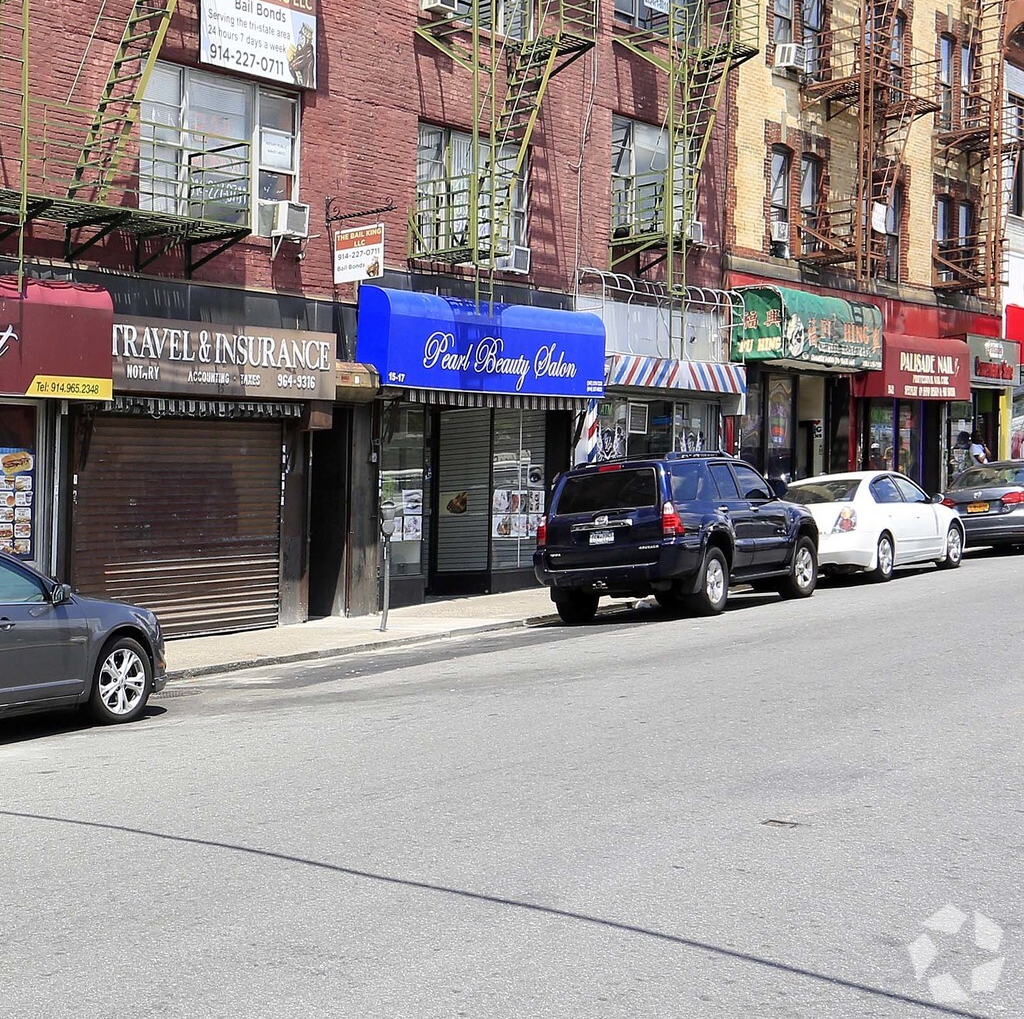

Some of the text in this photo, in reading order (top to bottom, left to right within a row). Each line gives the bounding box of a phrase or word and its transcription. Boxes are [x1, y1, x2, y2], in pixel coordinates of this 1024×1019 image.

[257, 3, 286, 23] Bonds
[208, 8, 291, 40] Serving the tri-state area
[208, 24, 217, 35] 24
[218, 28, 238, 41] hours
[240, 33, 245, 42] 7
[246, 35, 262, 49] days
[270, 42, 286, 53] week
[209, 43, 284, 76] 914-227-0711
[350, 231, 365, 239] BAIL
[366, 228, 382, 236] KING
[337, 248, 380, 261] 914-227-0711
[337, 262, 365, 272] Bail Bonds
[112, 324, 331, 371] TRAVEL & INSURANCE
[422, 331, 577, 391] Pearl Beauty Salon
[900, 352, 935, 373] PALISADE
[240, 374, 261, 386] TAXES
[388, 371, 406, 383] 15-17
[36, 382, 99, 394] Tel: 914.965.2348
